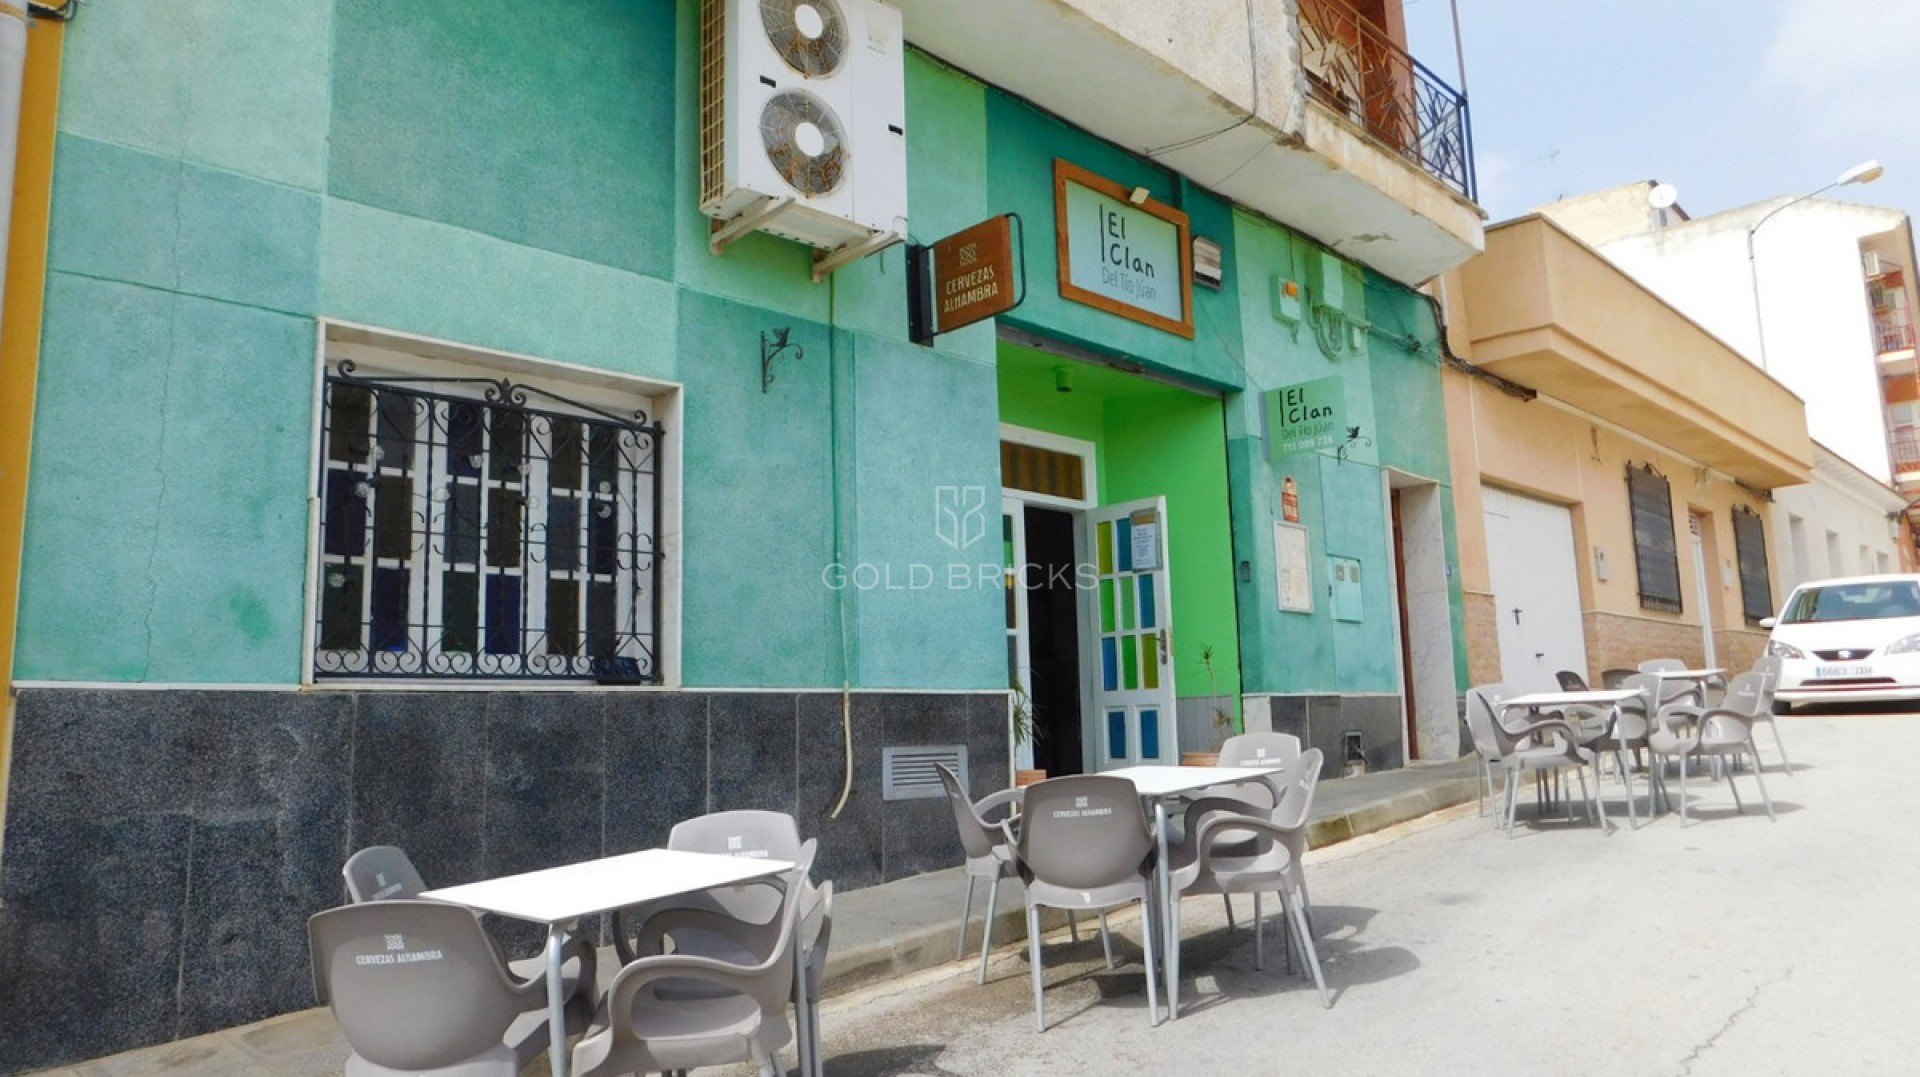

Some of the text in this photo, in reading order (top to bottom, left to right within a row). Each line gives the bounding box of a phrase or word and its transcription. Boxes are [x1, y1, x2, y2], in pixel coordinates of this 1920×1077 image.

[1108, 212, 1126, 240] El
[1110, 243, 1155, 278] Clan
[945, 264, 994, 295] CERVEZAS
[1102, 266, 1117, 288] Del
[943, 282, 999, 313] ALHAMBRA
[1287, 387, 1304, 406] El
[1289, 405, 1333, 424] Clan
[356, 949, 443, 965] CERVEZAS ALHAMBRA
